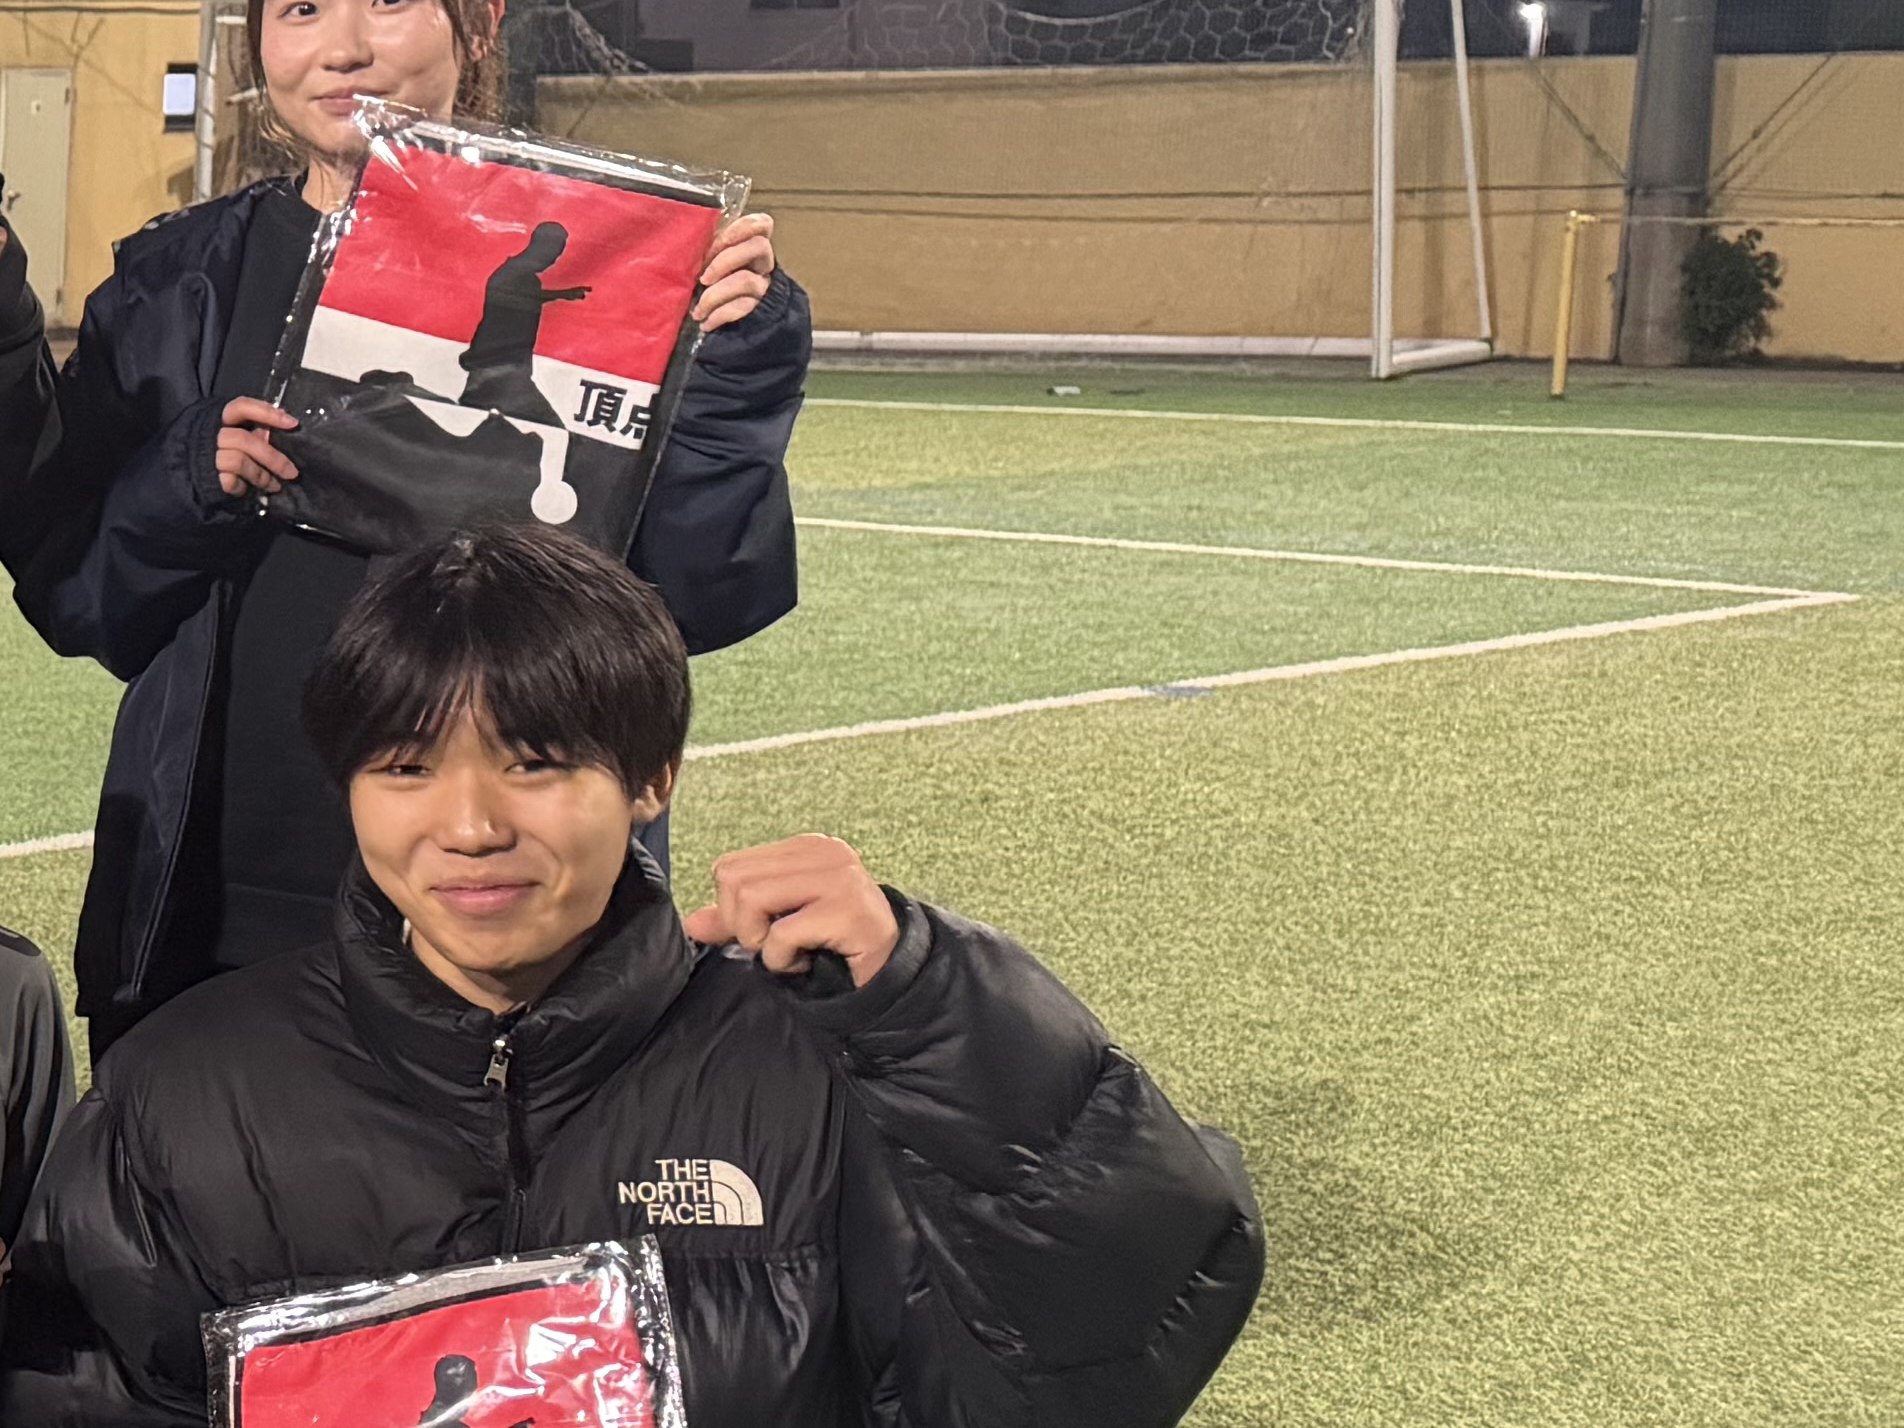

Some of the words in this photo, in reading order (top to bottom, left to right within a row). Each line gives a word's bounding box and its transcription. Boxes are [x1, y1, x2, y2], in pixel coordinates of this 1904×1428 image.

[654, 1158, 710, 1181] THE
[618, 1181, 711, 1204] NORTH
[646, 1203, 714, 1225] FACE
